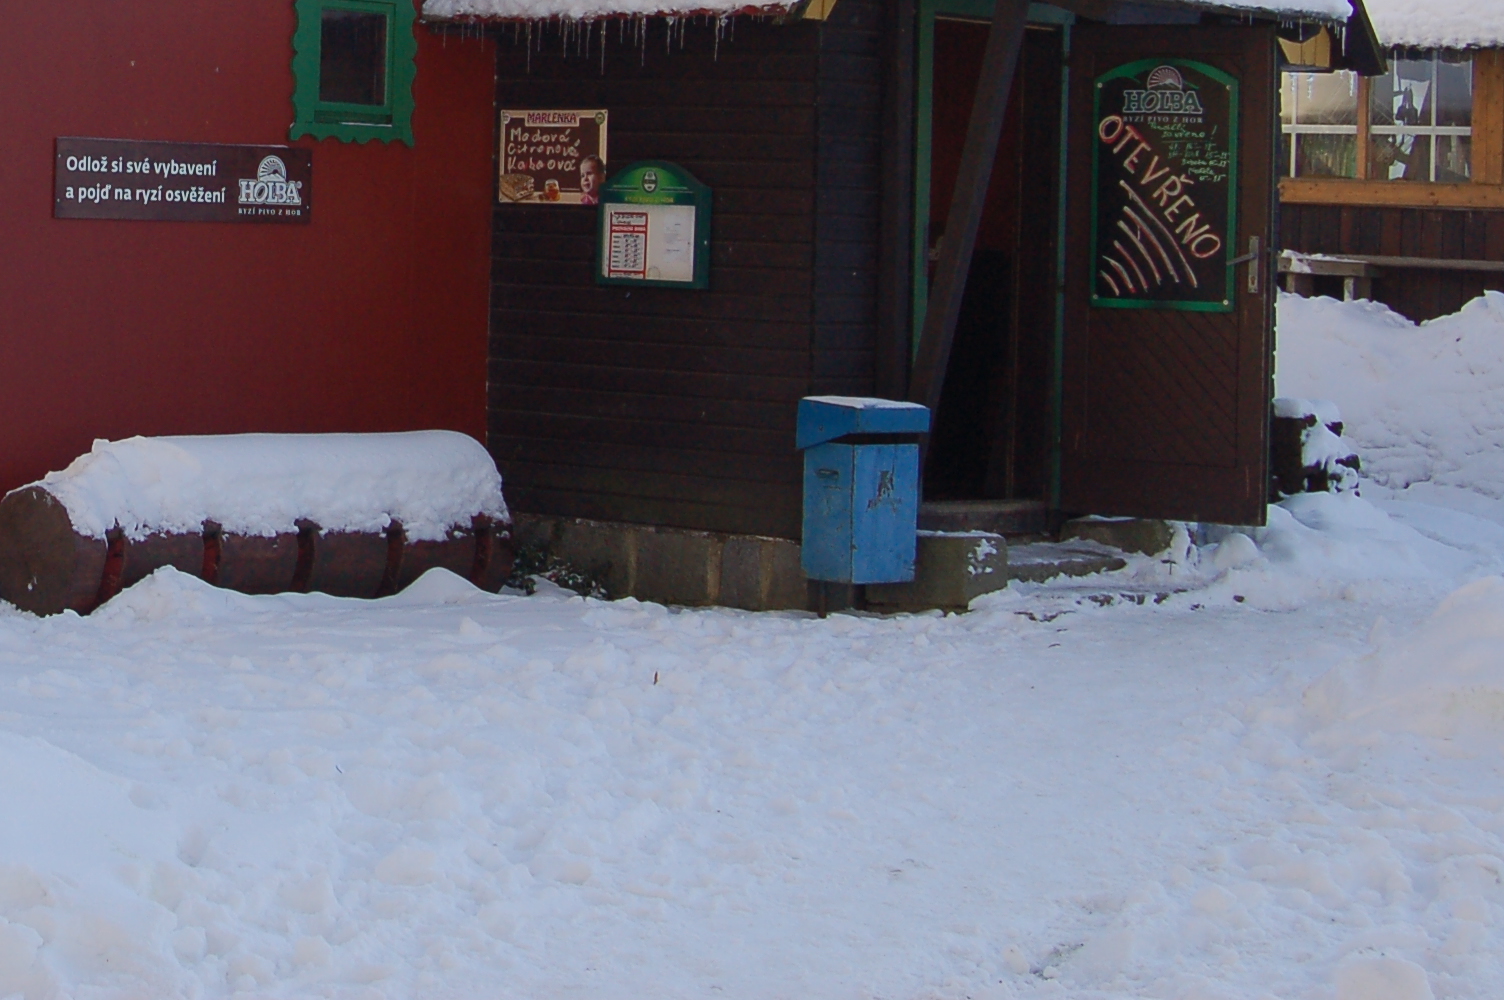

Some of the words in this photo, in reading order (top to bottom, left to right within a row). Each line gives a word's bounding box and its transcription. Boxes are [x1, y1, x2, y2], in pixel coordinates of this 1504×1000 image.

[1122, 90, 1203, 114] HOLBA
[527, 111, 577, 124] MARLENKA
[66, 155, 108, 173] Odlož
[111, 156, 123, 173] si
[126, 157, 150, 174] své
[153, 159, 218, 178] vybavení
[65, 186, 74, 198] a
[78, 184, 112, 204] pojď
[114, 188, 132, 201] na
[135, 185, 163, 205] ryzí
[165, 186, 227, 204] osvěžení
[1099, 115, 1221, 258] OTEVŘENO
